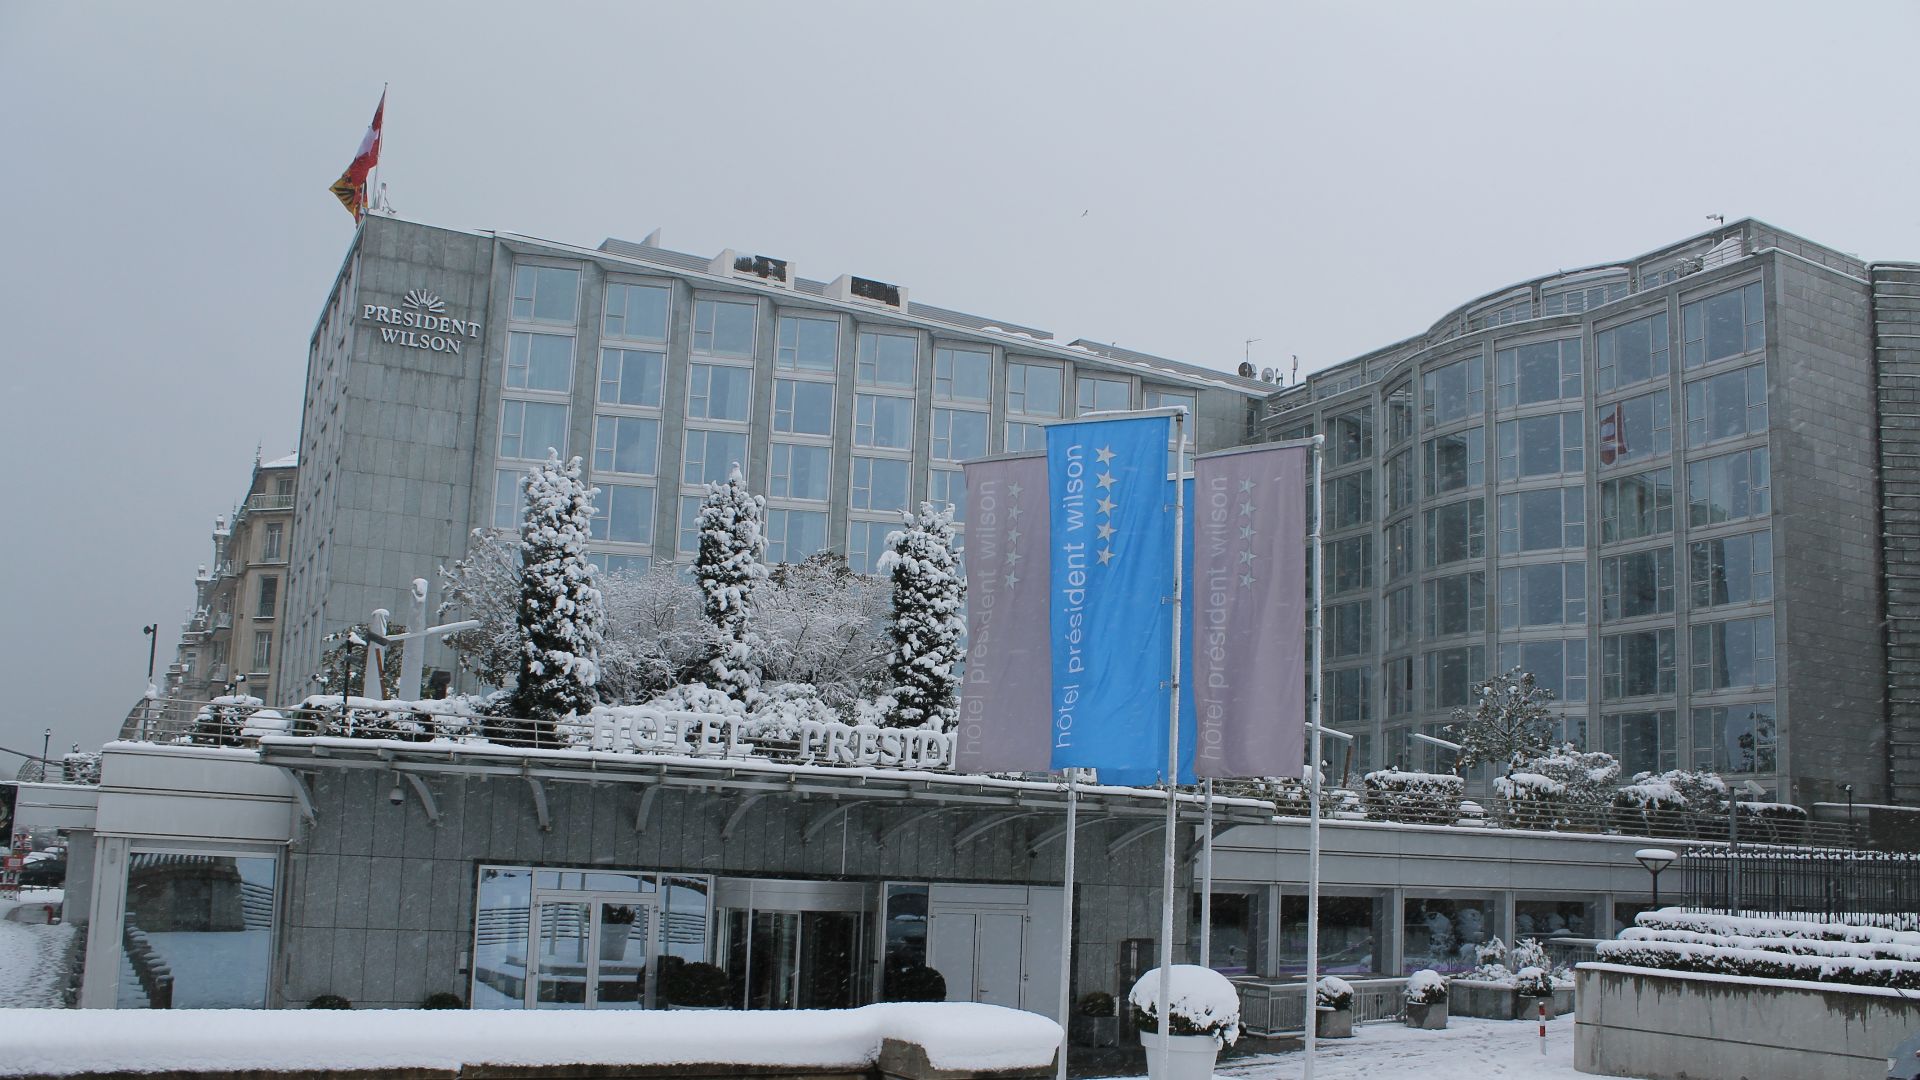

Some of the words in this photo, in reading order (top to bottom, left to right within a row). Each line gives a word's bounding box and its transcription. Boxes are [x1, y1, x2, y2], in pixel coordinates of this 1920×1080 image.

[362, 304, 481, 338] PRESIDENT
[380, 327, 461, 354] WILSON
[1063, 446, 1083, 531] wilson
[1206, 477, 1228, 557] wilson
[963, 695, 984, 755] hôtel
[976, 481, 996, 560] wilson
[1064, 543, 1086, 673] président
[1204, 567, 1229, 689] président
[591, 706, 754, 754] HOTEL
[1055, 683, 1080, 749] hôtel
[1200, 698, 1224, 760] hôtel
